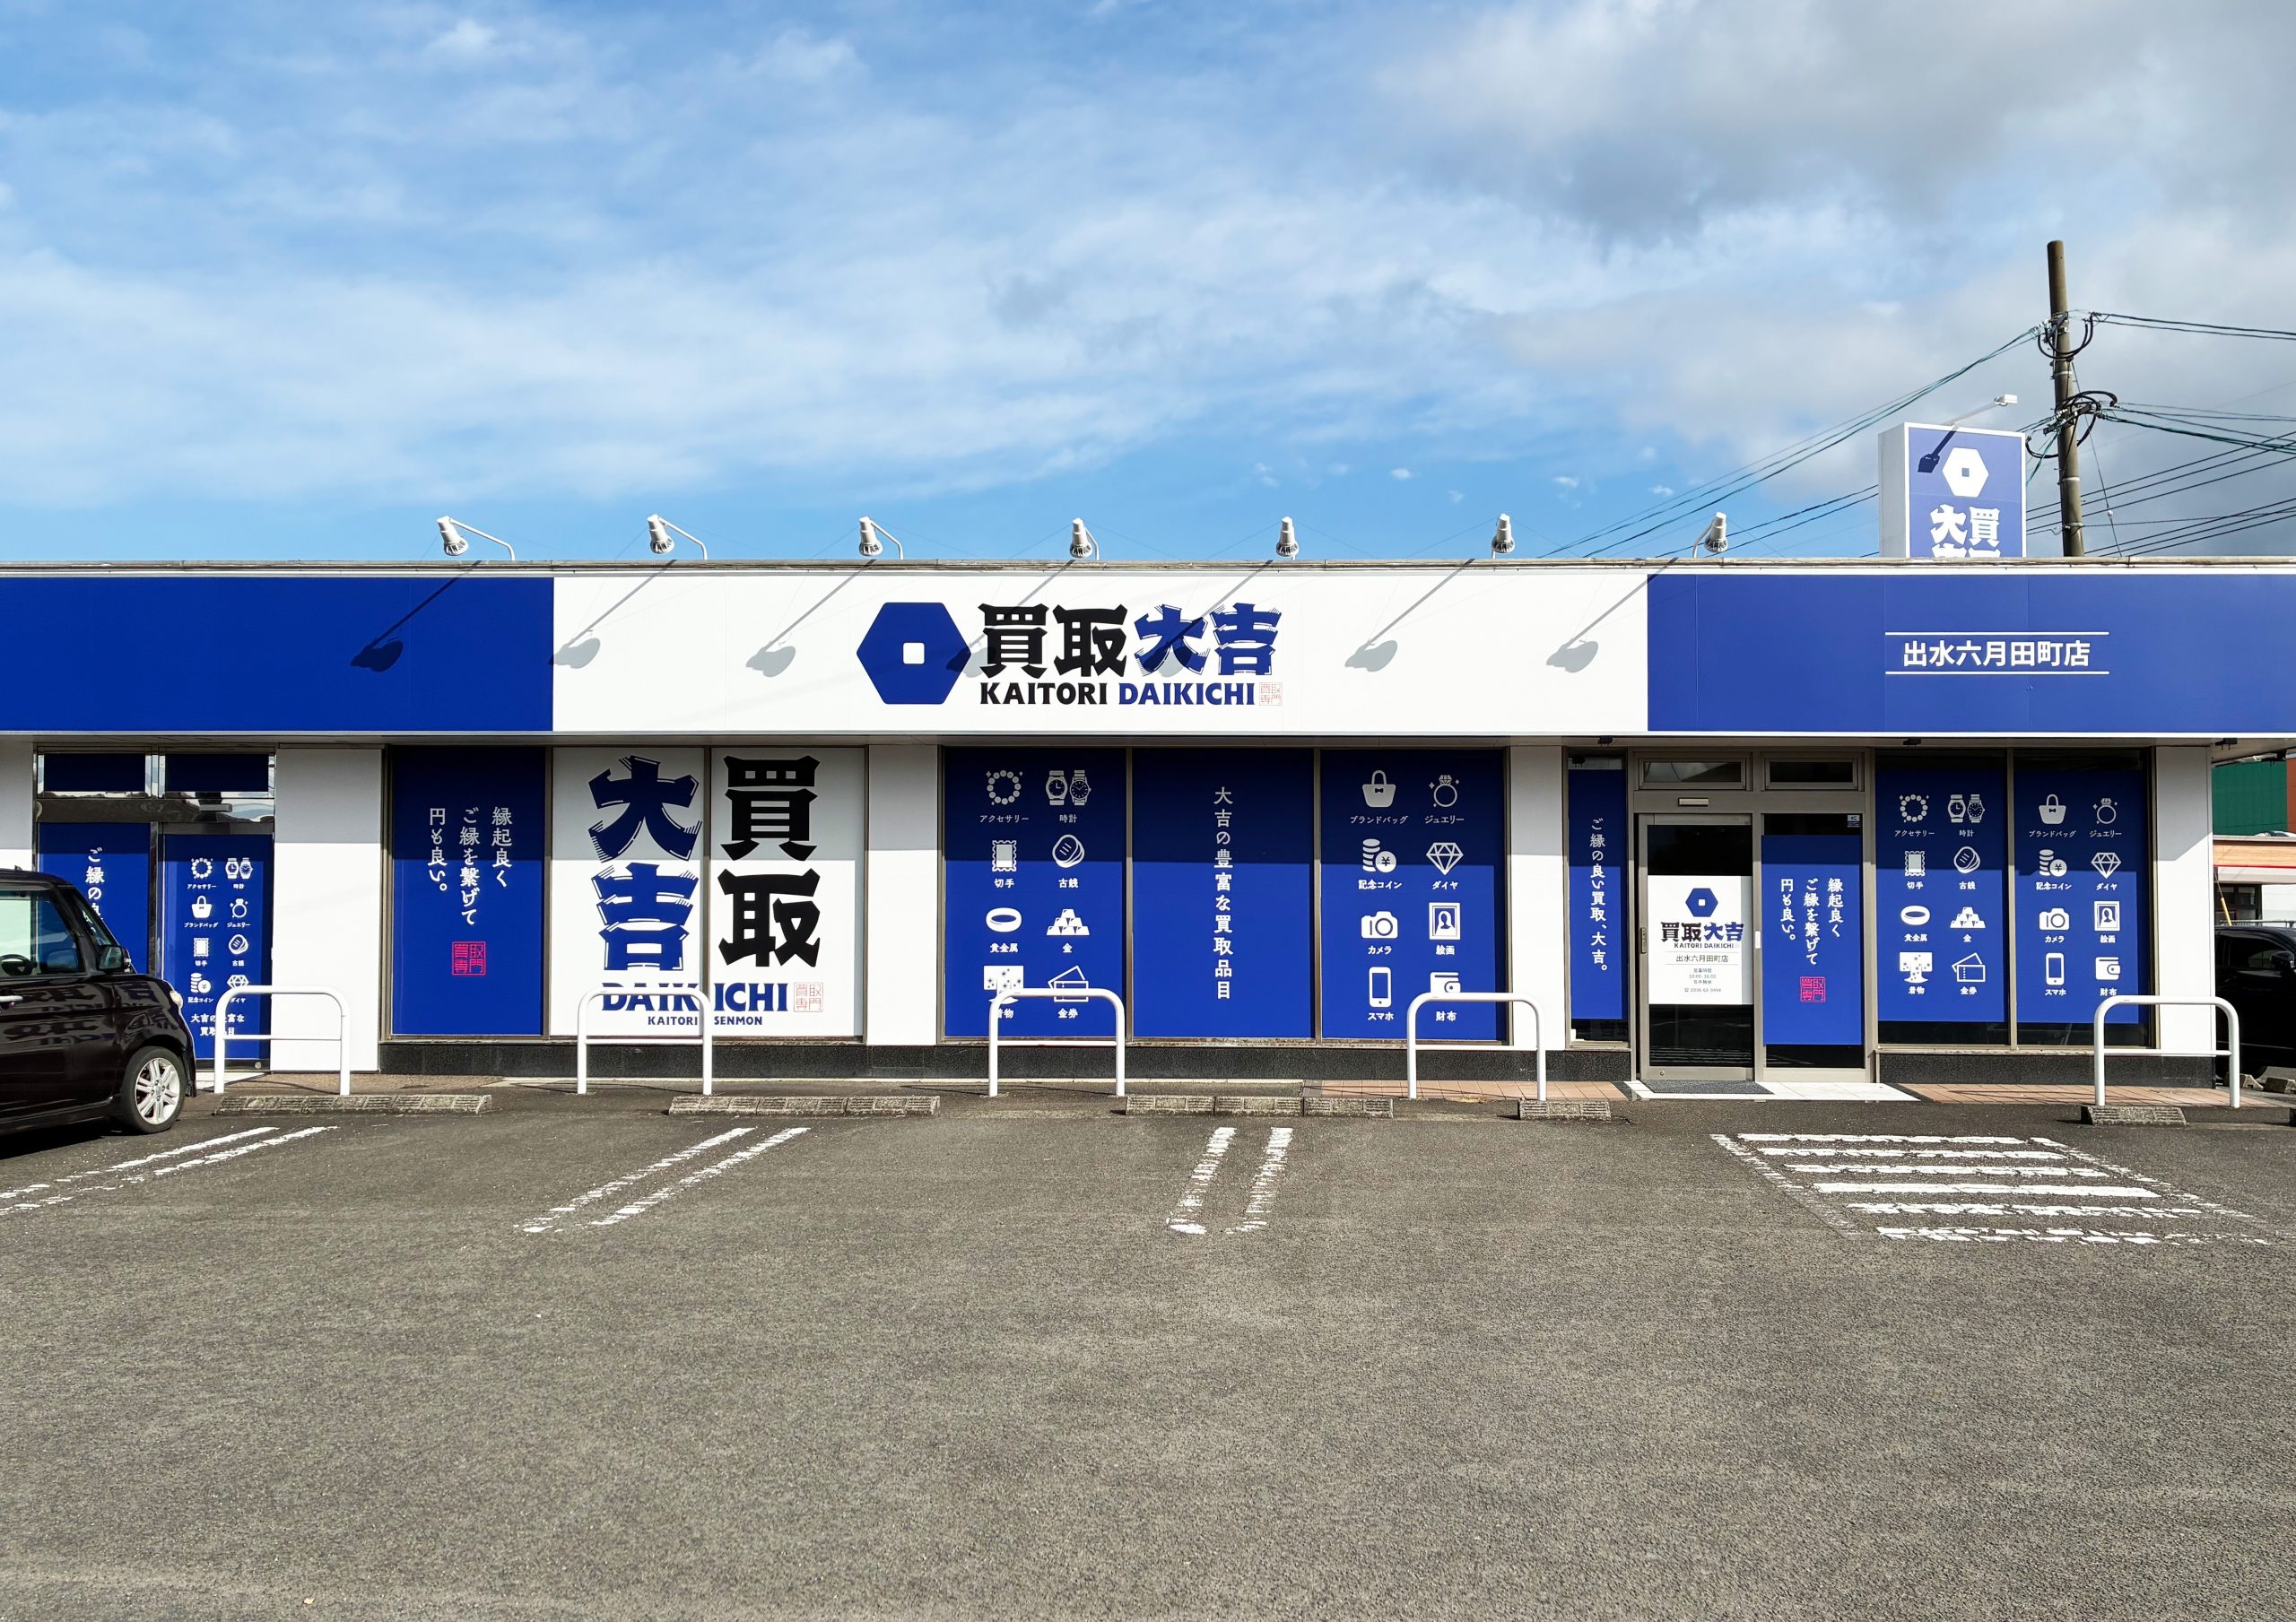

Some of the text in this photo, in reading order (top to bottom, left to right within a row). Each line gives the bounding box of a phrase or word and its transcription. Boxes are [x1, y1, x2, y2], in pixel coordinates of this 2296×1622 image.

[1969, 507, 2001, 558] 買
[978, 603, 1282, 679] 買取大吉
[1904, 640, 2090, 666] 出水六月田町店
[980, 682, 1255, 705] KAITORI DAIKICHI
[979, 814, 1030, 823] アクセサリー
[1060, 814, 1077, 823] 時計
[1350, 815, 1409, 825] ブランドバッグ
[1425, 815, 1464, 824] ジュエリー
[1894, 829, 1935, 837] アクセサリー
[1959, 828, 1975, 837] 時計
[2029, 829, 2077, 838] ブランドバッグ
[2089, 829, 2122, 838] ジュエリー
[427, 807, 448, 891] 円も良い。
[491, 807, 513, 888] 縁起良く
[458, 807, 481, 925] ご縁を繋げて
[588, 755, 702, 971] 大吉
[718, 755, 821, 967] 買取
[995, 879, 1014, 888] 切手
[1058, 878, 1078, 888] 古銭
[1358, 880, 1402, 889] 記念コイン
[1431, 880, 1458, 890] ダイヤ
[1906, 880, 1924, 890] 切手
[1959, 880, 1977, 890] 古銭
[2035, 880, 2073, 890] 記念コイン
[2096, 882, 2118, 891] ダイヤ
[1213, 786, 1233, 999] 大吉の豊富な買取品目
[1589, 818, 1607, 971] ご縁の良い買取、大吉。
[1780, 878, 1796, 941] 円も良い。
[1827, 877, 1844, 938] 縁起良く
[227, 921, 251, 929] ジュエリー
[1804, 878, 1822, 966] ご縁を繋げて
[1660, 921, 1744, 942] 買取大吉
[1904, 932, 1928, 942] 貴金属
[1962, 933, 1972, 943] 金
[2044, 934, 2065, 943] カメラ
[2100, 934, 2116, 944] 絵画
[990, 943, 1018, 952] 貴金属
[1063, 943, 1072, 952] 金
[1368, 945, 1393, 955] カメラ
[1436, 945, 1455, 955] 絵画
[1675, 954, 1729, 963] 出水六月田町店
[1908, 985, 1926, 995] 着物
[1960, 985, 1978, 995] 金券
[2044, 988, 2066, 996] スマホ
[2100, 988, 2117, 996] 財布
[602, 983, 788, 1012] DAIKICHI
[190, 1013, 245, 1023] 大吉の富な
[1058, 1008, 1078, 1019] 金券
[1367, 1011, 1395, 1021] スマホ
[1436, 1011, 1457, 1021] 財布
[648, 1016, 762, 1026] KAITORI SENMON
[199, 1027, 235, 1037] 買取目
